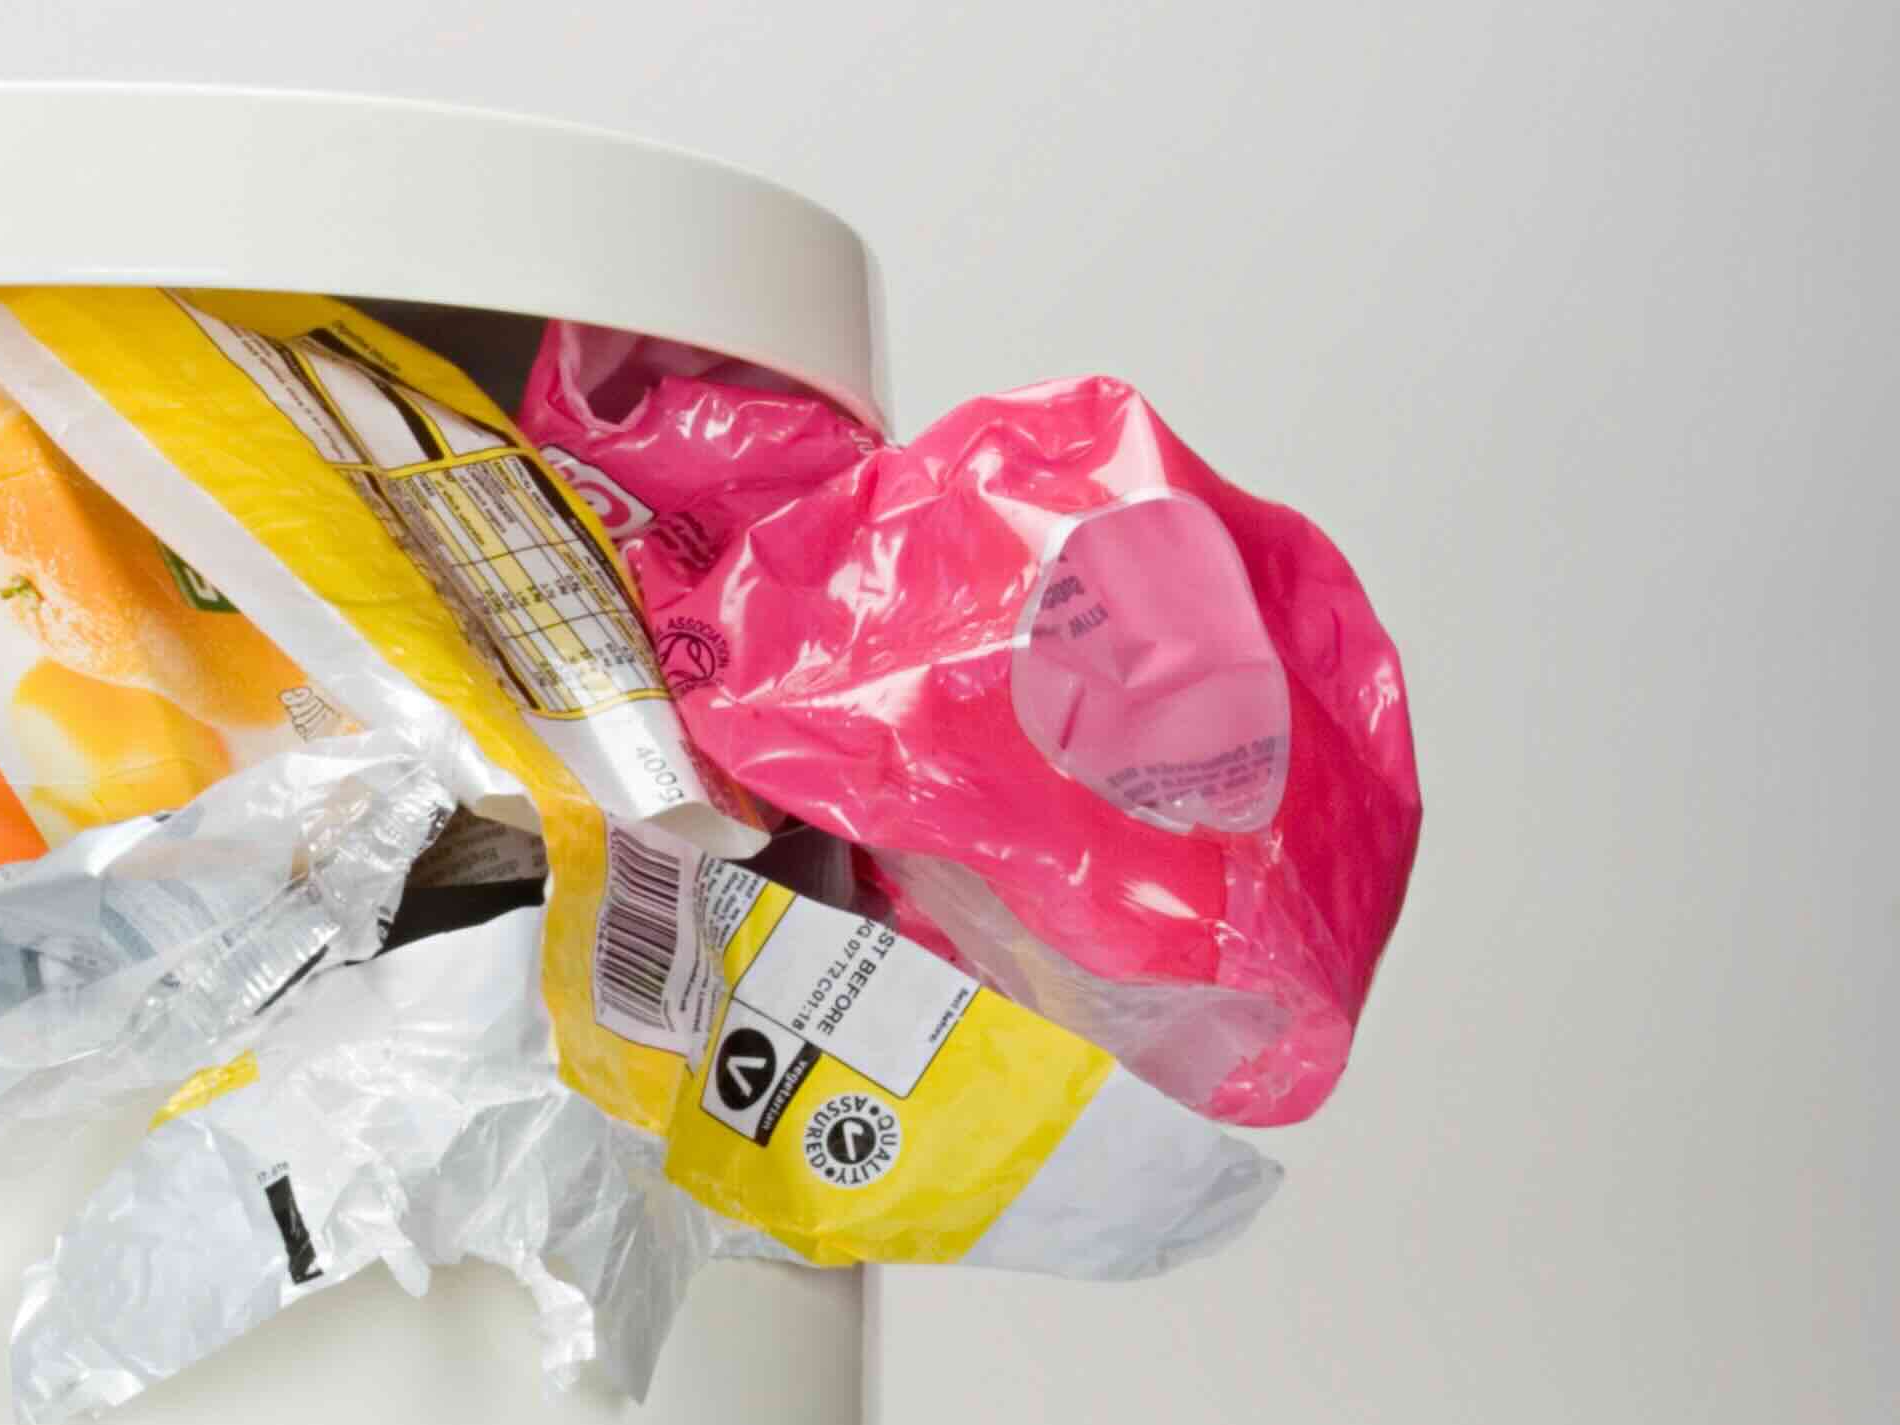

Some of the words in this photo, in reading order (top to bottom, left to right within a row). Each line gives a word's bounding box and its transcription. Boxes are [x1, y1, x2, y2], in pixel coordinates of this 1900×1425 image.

[668, 616, 731, 669] ASSOCIATION
[842, 938, 863, 961] 07
[872, 921, 898, 961] ST
[817, 958, 878, 1036] BEFORE
[761, 1055, 810, 1133] vegetarian
[803, 1095, 870, 1169] ASSURED
[835, 1112, 898, 1186] QUALITY
